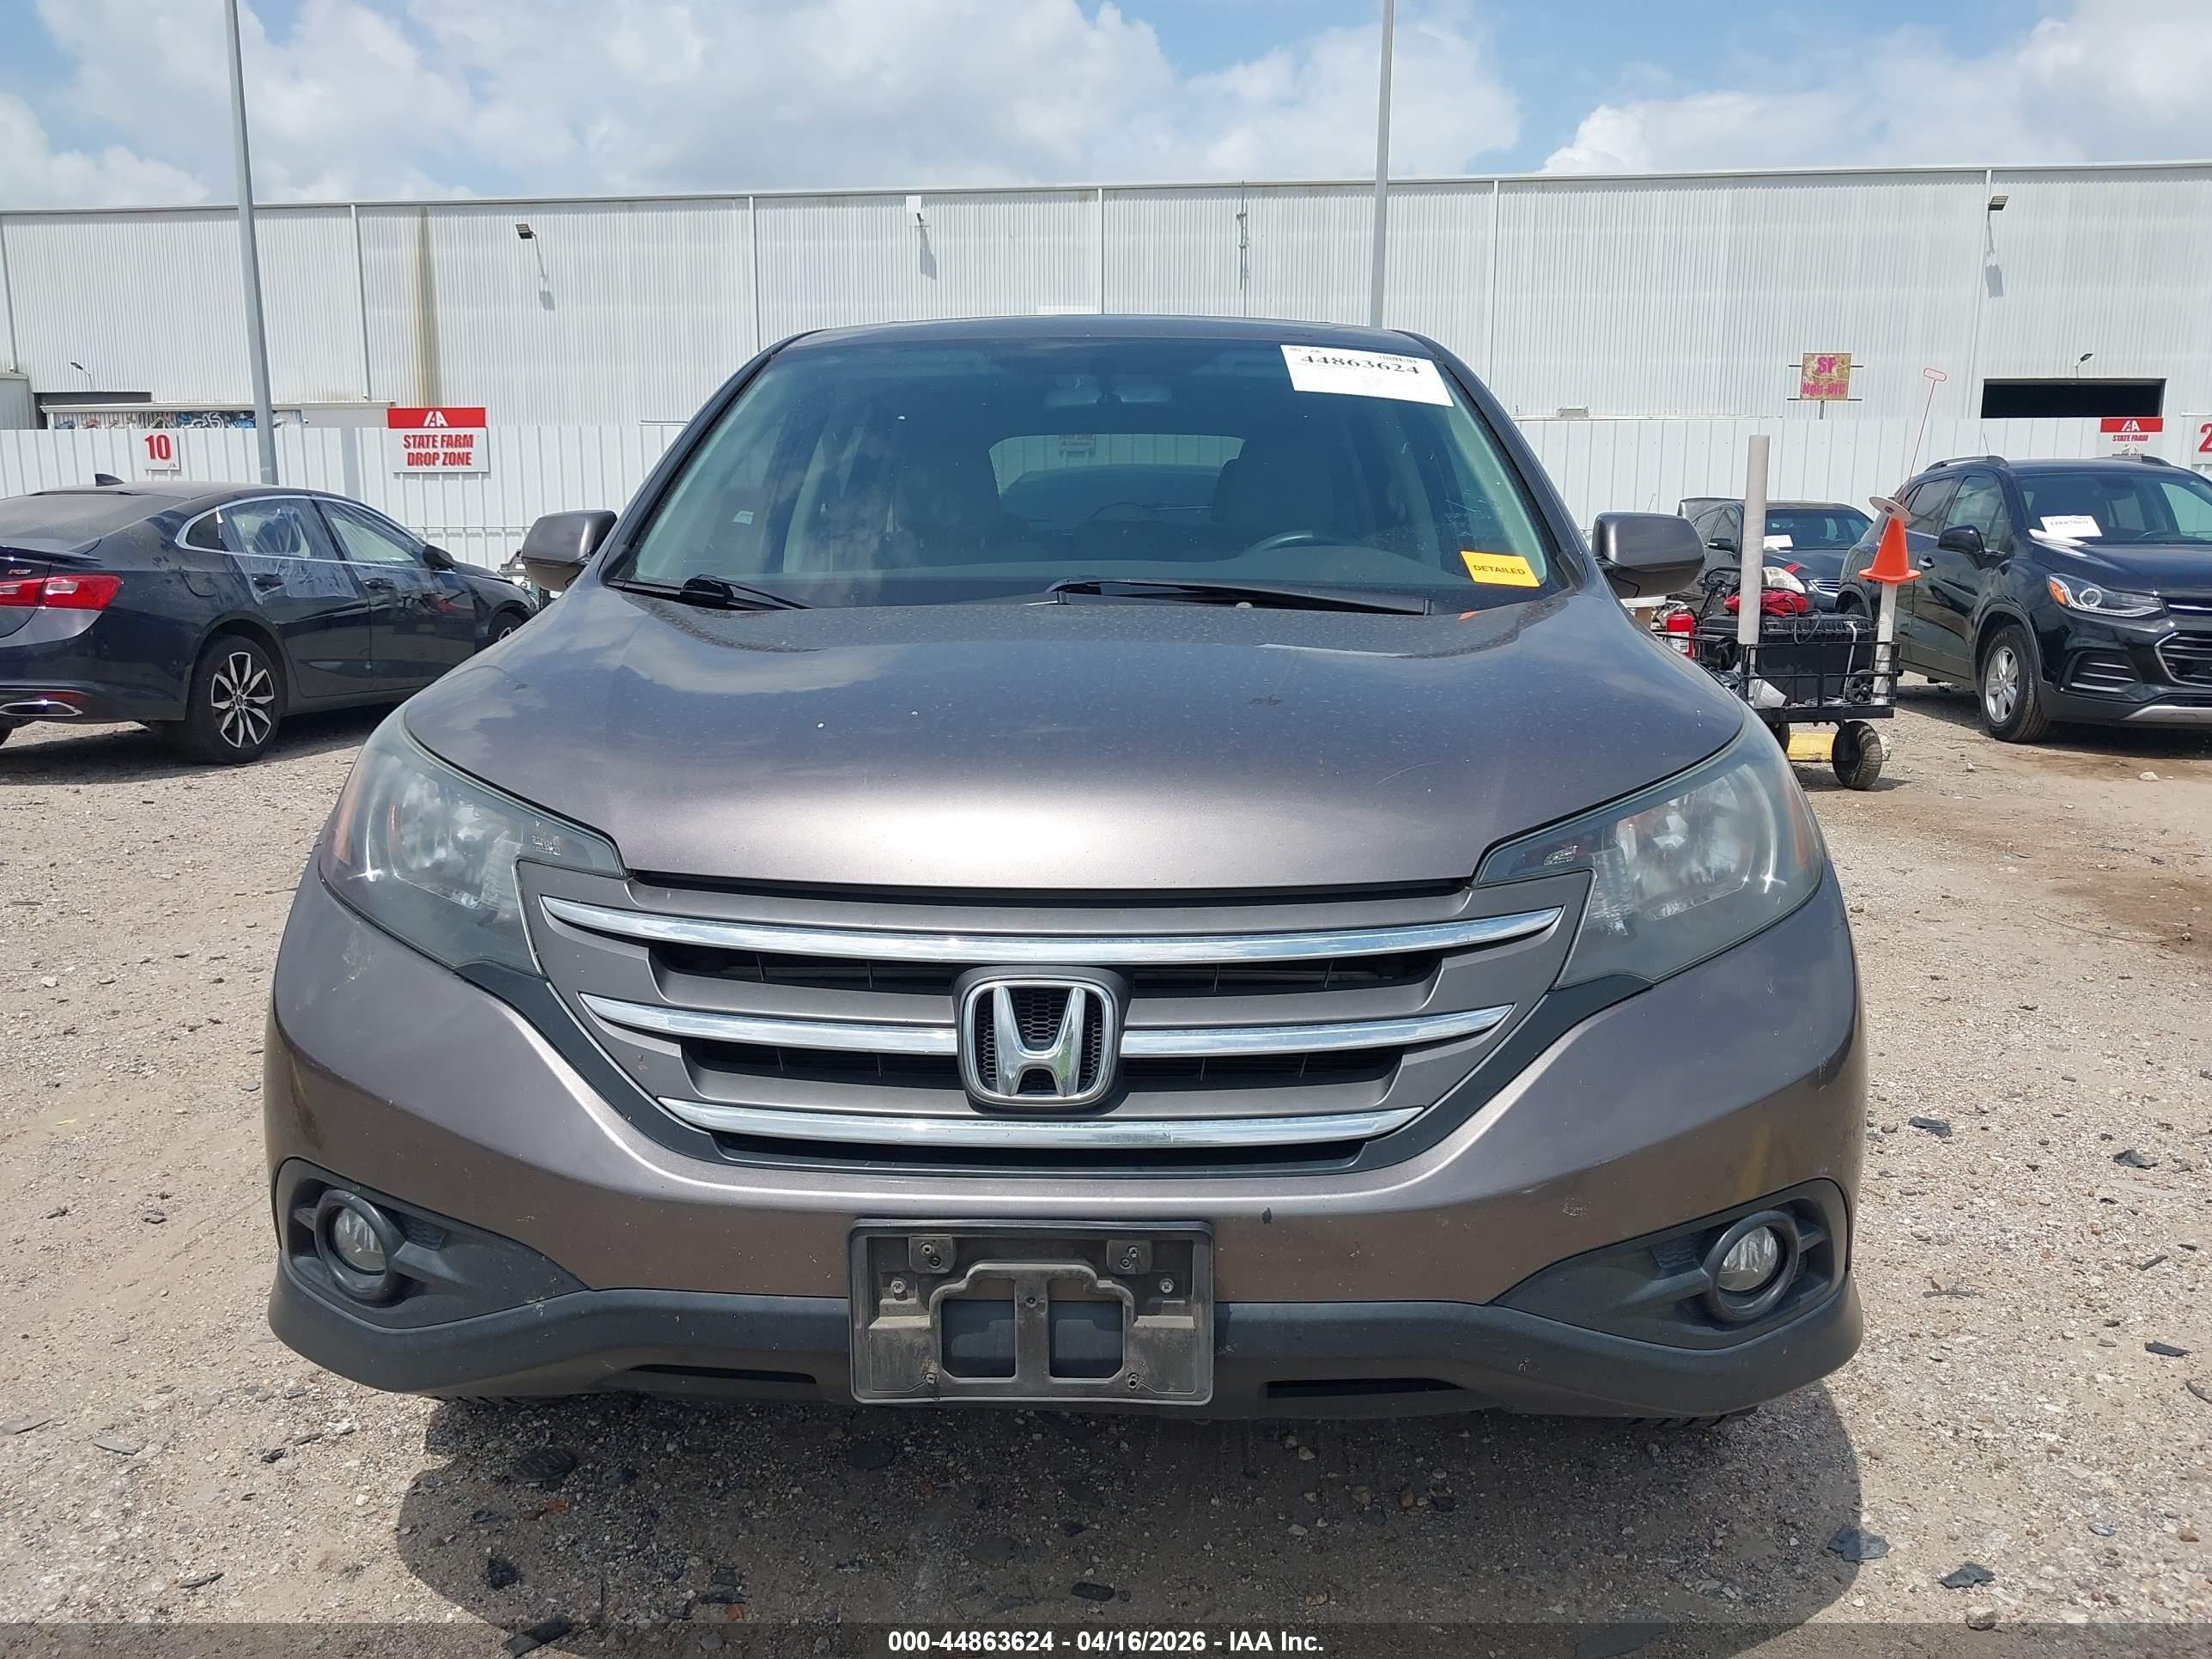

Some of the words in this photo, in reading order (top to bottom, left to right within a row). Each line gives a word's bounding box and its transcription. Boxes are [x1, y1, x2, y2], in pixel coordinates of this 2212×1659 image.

[1301, 354, 1419, 374] 44863624
[144, 434, 171, 459] 10
[403, 434, 438, 448] STATE
[441, 434, 474, 448] FARM
[407, 452, 440, 466] DROP
[442, 452, 472, 465] ZONE
[1473, 564, 1526, 574] DETAILED
